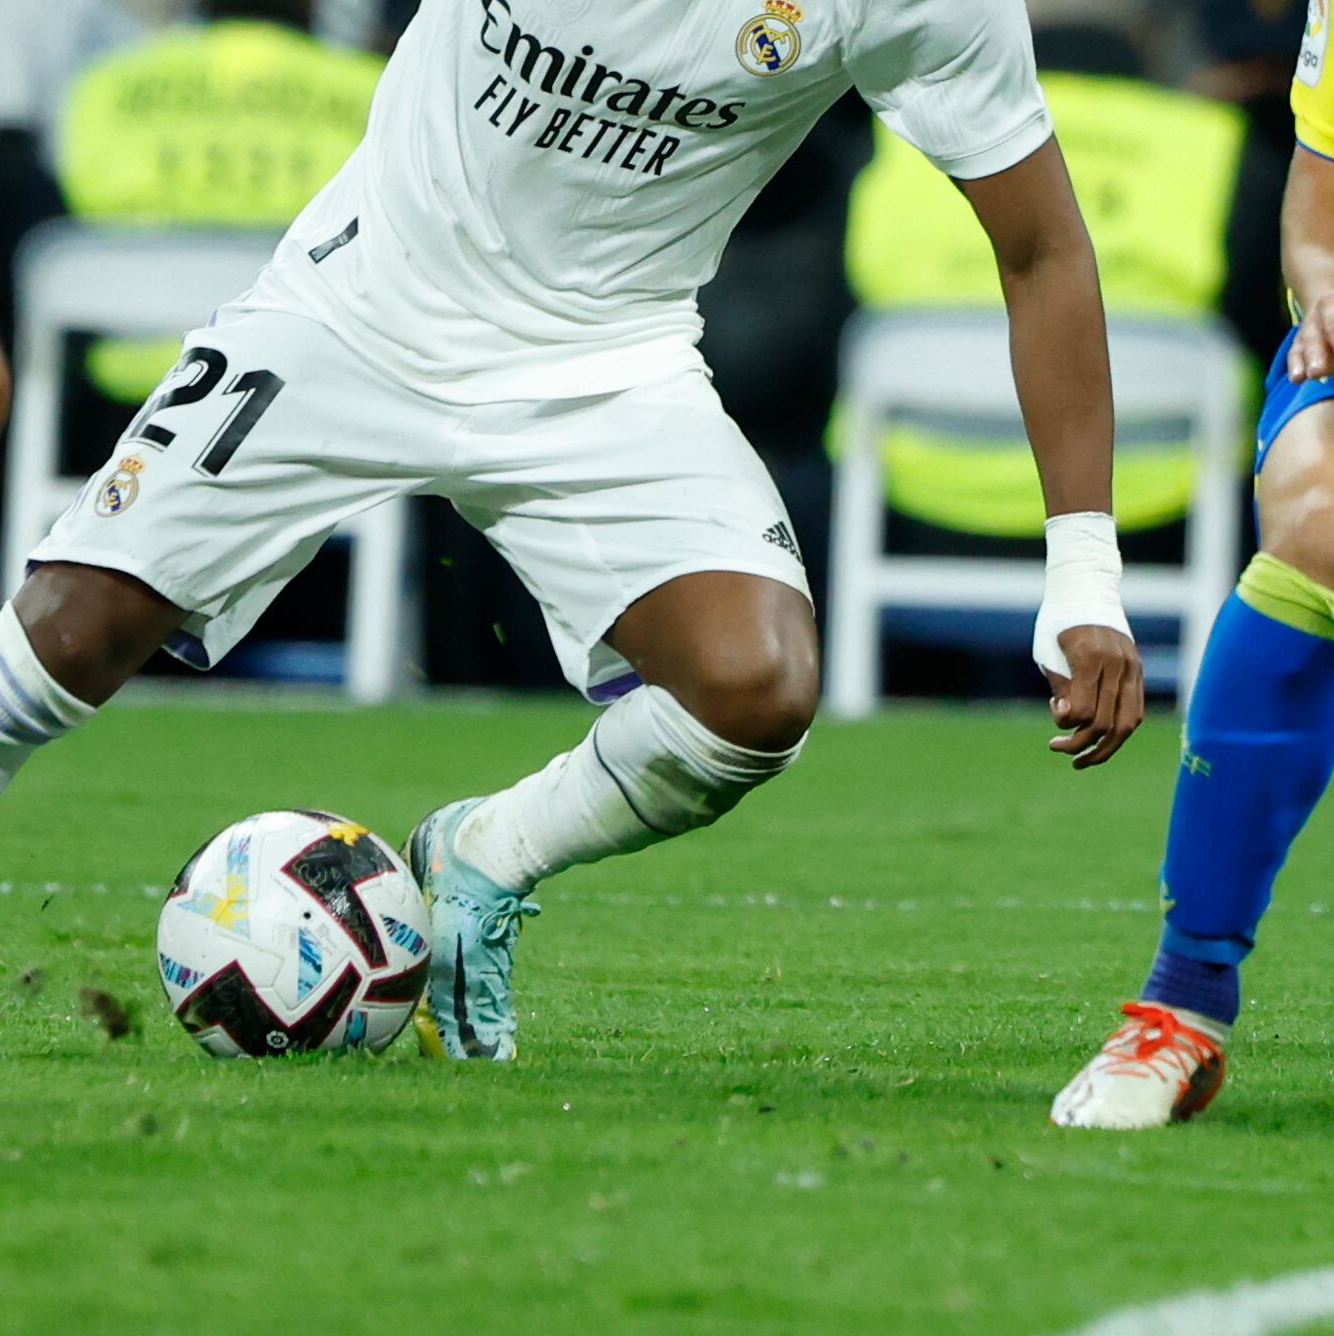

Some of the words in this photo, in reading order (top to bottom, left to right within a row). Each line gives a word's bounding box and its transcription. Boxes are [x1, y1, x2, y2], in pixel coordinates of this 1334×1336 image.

[473, 73, 542, 138] FLY
[534, 107, 681, 177] BETTER
[121, 346, 286, 479] 21
